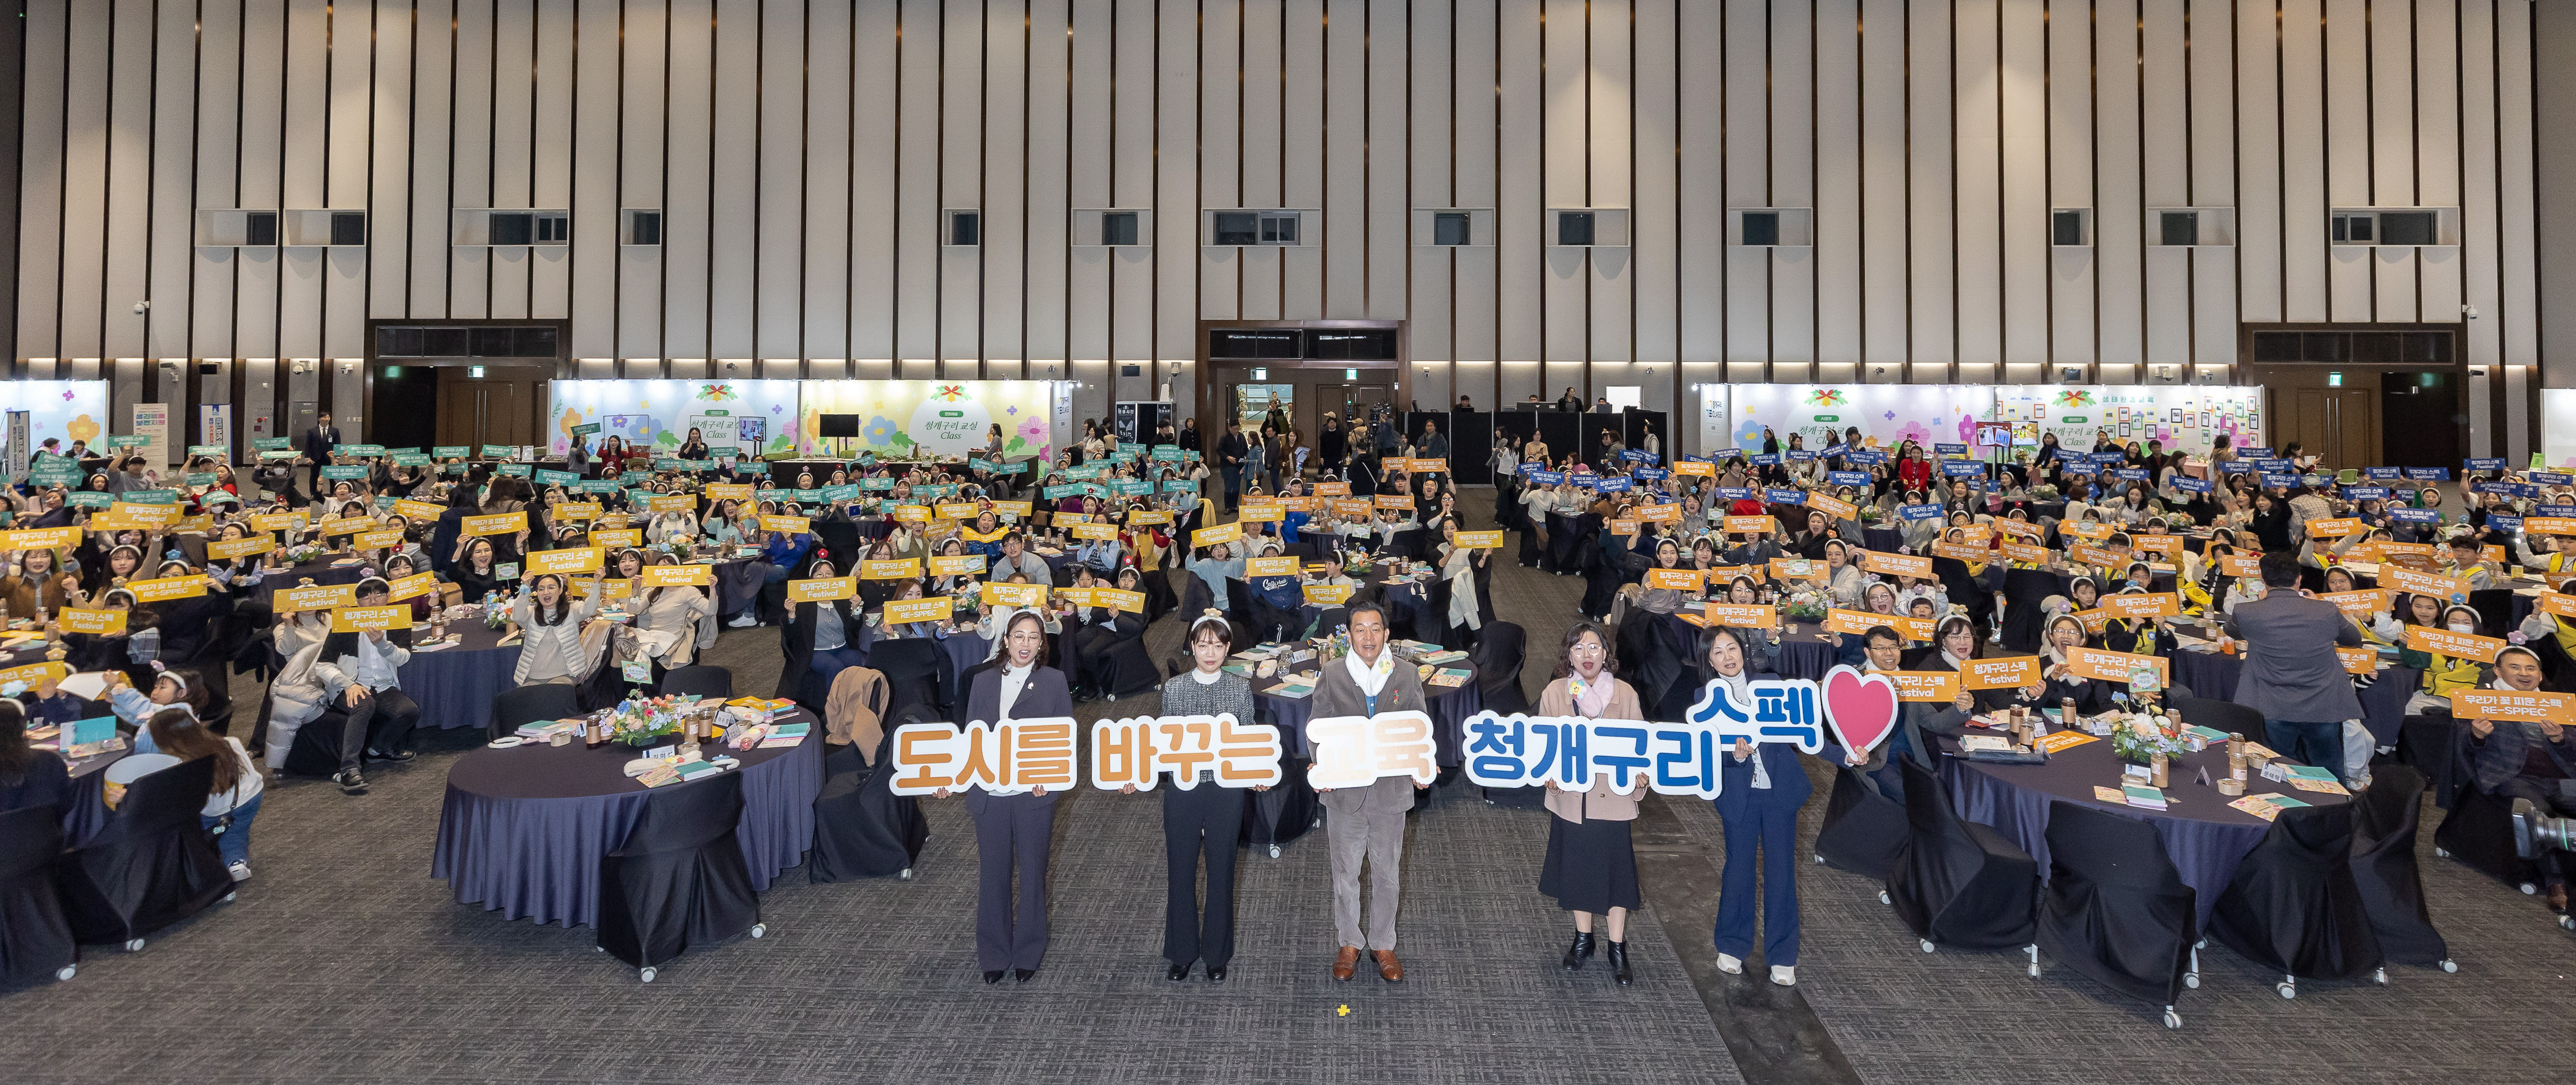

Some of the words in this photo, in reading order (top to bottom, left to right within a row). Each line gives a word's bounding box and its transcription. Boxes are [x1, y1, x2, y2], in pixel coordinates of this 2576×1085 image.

[925, 421, 959, 430] 청개구리
[960, 421, 978, 430] 교실
[706, 430, 726, 438] Class
[941, 431, 961, 439] Class
[2064, 437, 2087, 446] Class
[478, 523, 512, 532] RE-SPPEC
[540, 552, 574, 563] 청개구리
[576, 551, 592, 560] 스펙
[549, 560, 584, 570] Festival
[1880, 564, 1916, 572] RE-SPPEC
[2393, 571, 2432, 585] 청개구리
[2434, 579, 2455, 589] 스펙
[800, 582, 829, 590] 청개구리
[993, 586, 1020, 595] 청개구리
[2401, 580, 2443, 595] Festival
[290, 589, 327, 600] 청개구리
[329, 588, 347, 597] 스펙
[807, 589, 838, 598] Festival
[2361, 592, 2379, 600] 스펙
[299, 598, 337, 607] Festival
[2115, 598, 2148, 606] 청개구리
[2151, 597, 2166, 605] 스펙
[344, 610, 377, 619] 청개구리
[380, 609, 397, 618] 스펙
[901, 609, 936, 618] RE-SPPEC
[1717, 607, 1747, 616] 청개구리
[2126, 606, 2160, 614] Festival
[353, 619, 388, 628] Festival
[1725, 616, 1756, 624] Festival
[73, 621, 104, 630] Festival
[2419, 632, 2444, 641] 우리가
[2456, 638, 2473, 647] 피운
[2476, 641, 2494, 650] 스펙
[2430, 641, 2481, 655] RE-SPPEC
[2084, 653, 2126, 667] 청개구리
[2129, 658, 2151, 668] 스펙
[1974, 663, 2008, 674] 청개구리
[2010, 662, 2027, 672] 스펙
[2094, 666, 2129, 677] Festiv
[1924, 676, 1945, 686] 스펙
[1984, 673, 2020, 684] Festival
[2465, 696, 2498, 704] 우리가
[2500, 697, 2511, 705] 꽃
[2513, 697, 2536, 706] 피운
[2539, 699, 2562, 708] 스펙
[2481, 706, 2547, 716] RE-SPPEC
[896, 724, 1072, 788] 도시를
[1099, 721, 1274, 783] 바꾸는
[1315, 718, 1430, 783] 교육
[1470, 718, 1713, 791] 청개구리
[1693, 687, 1816, 747] 스펙
